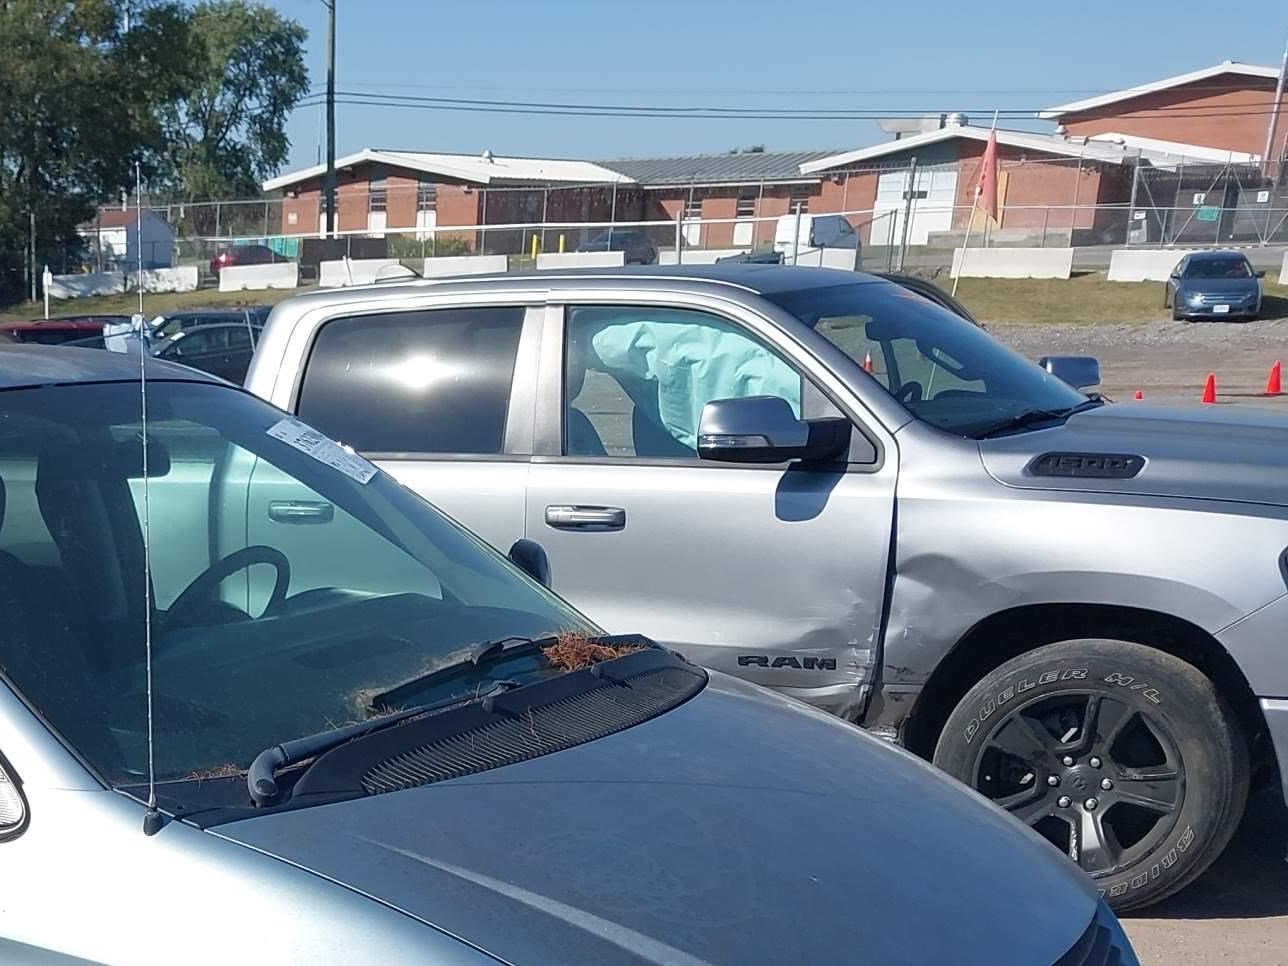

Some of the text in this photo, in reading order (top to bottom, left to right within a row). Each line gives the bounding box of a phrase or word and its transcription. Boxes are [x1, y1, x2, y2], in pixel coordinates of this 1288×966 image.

[738, 655, 837, 671] RAM
[964, 668, 1161, 744] DUELER H/L
